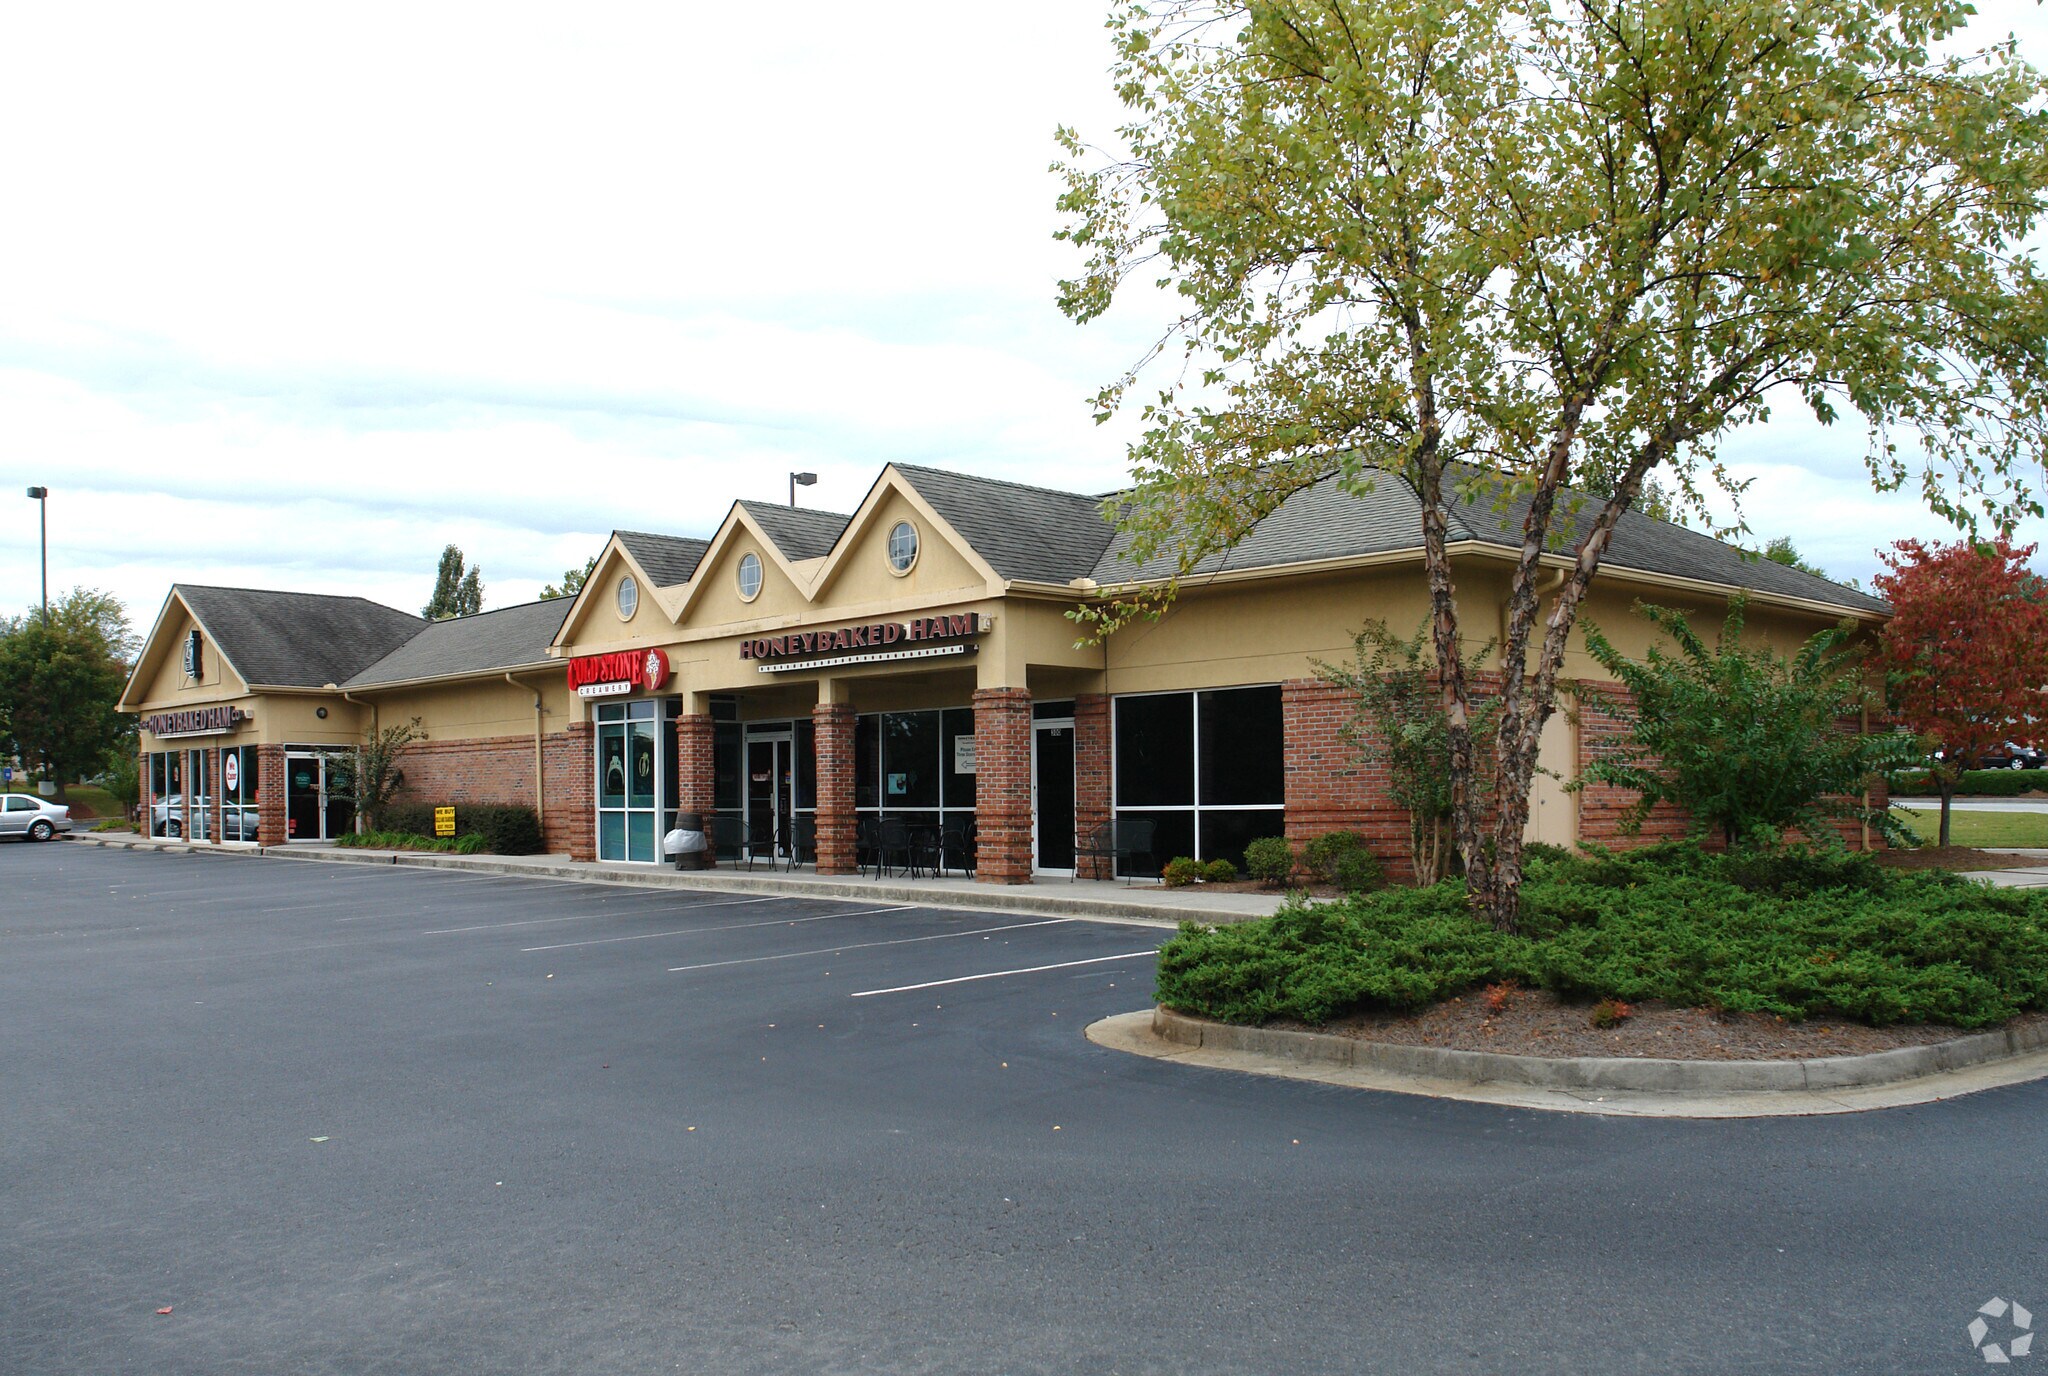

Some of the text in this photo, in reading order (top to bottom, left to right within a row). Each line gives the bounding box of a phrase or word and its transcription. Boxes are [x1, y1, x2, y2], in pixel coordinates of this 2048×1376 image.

[739, 612, 974, 660] HONEYBAKED HAM
[567, 650, 642, 691] COLD STONE
[579, 683, 629, 695] CREAMERY
[150, 710, 207, 735] HONEYBAKED
[207, 705, 232, 728] HAM
